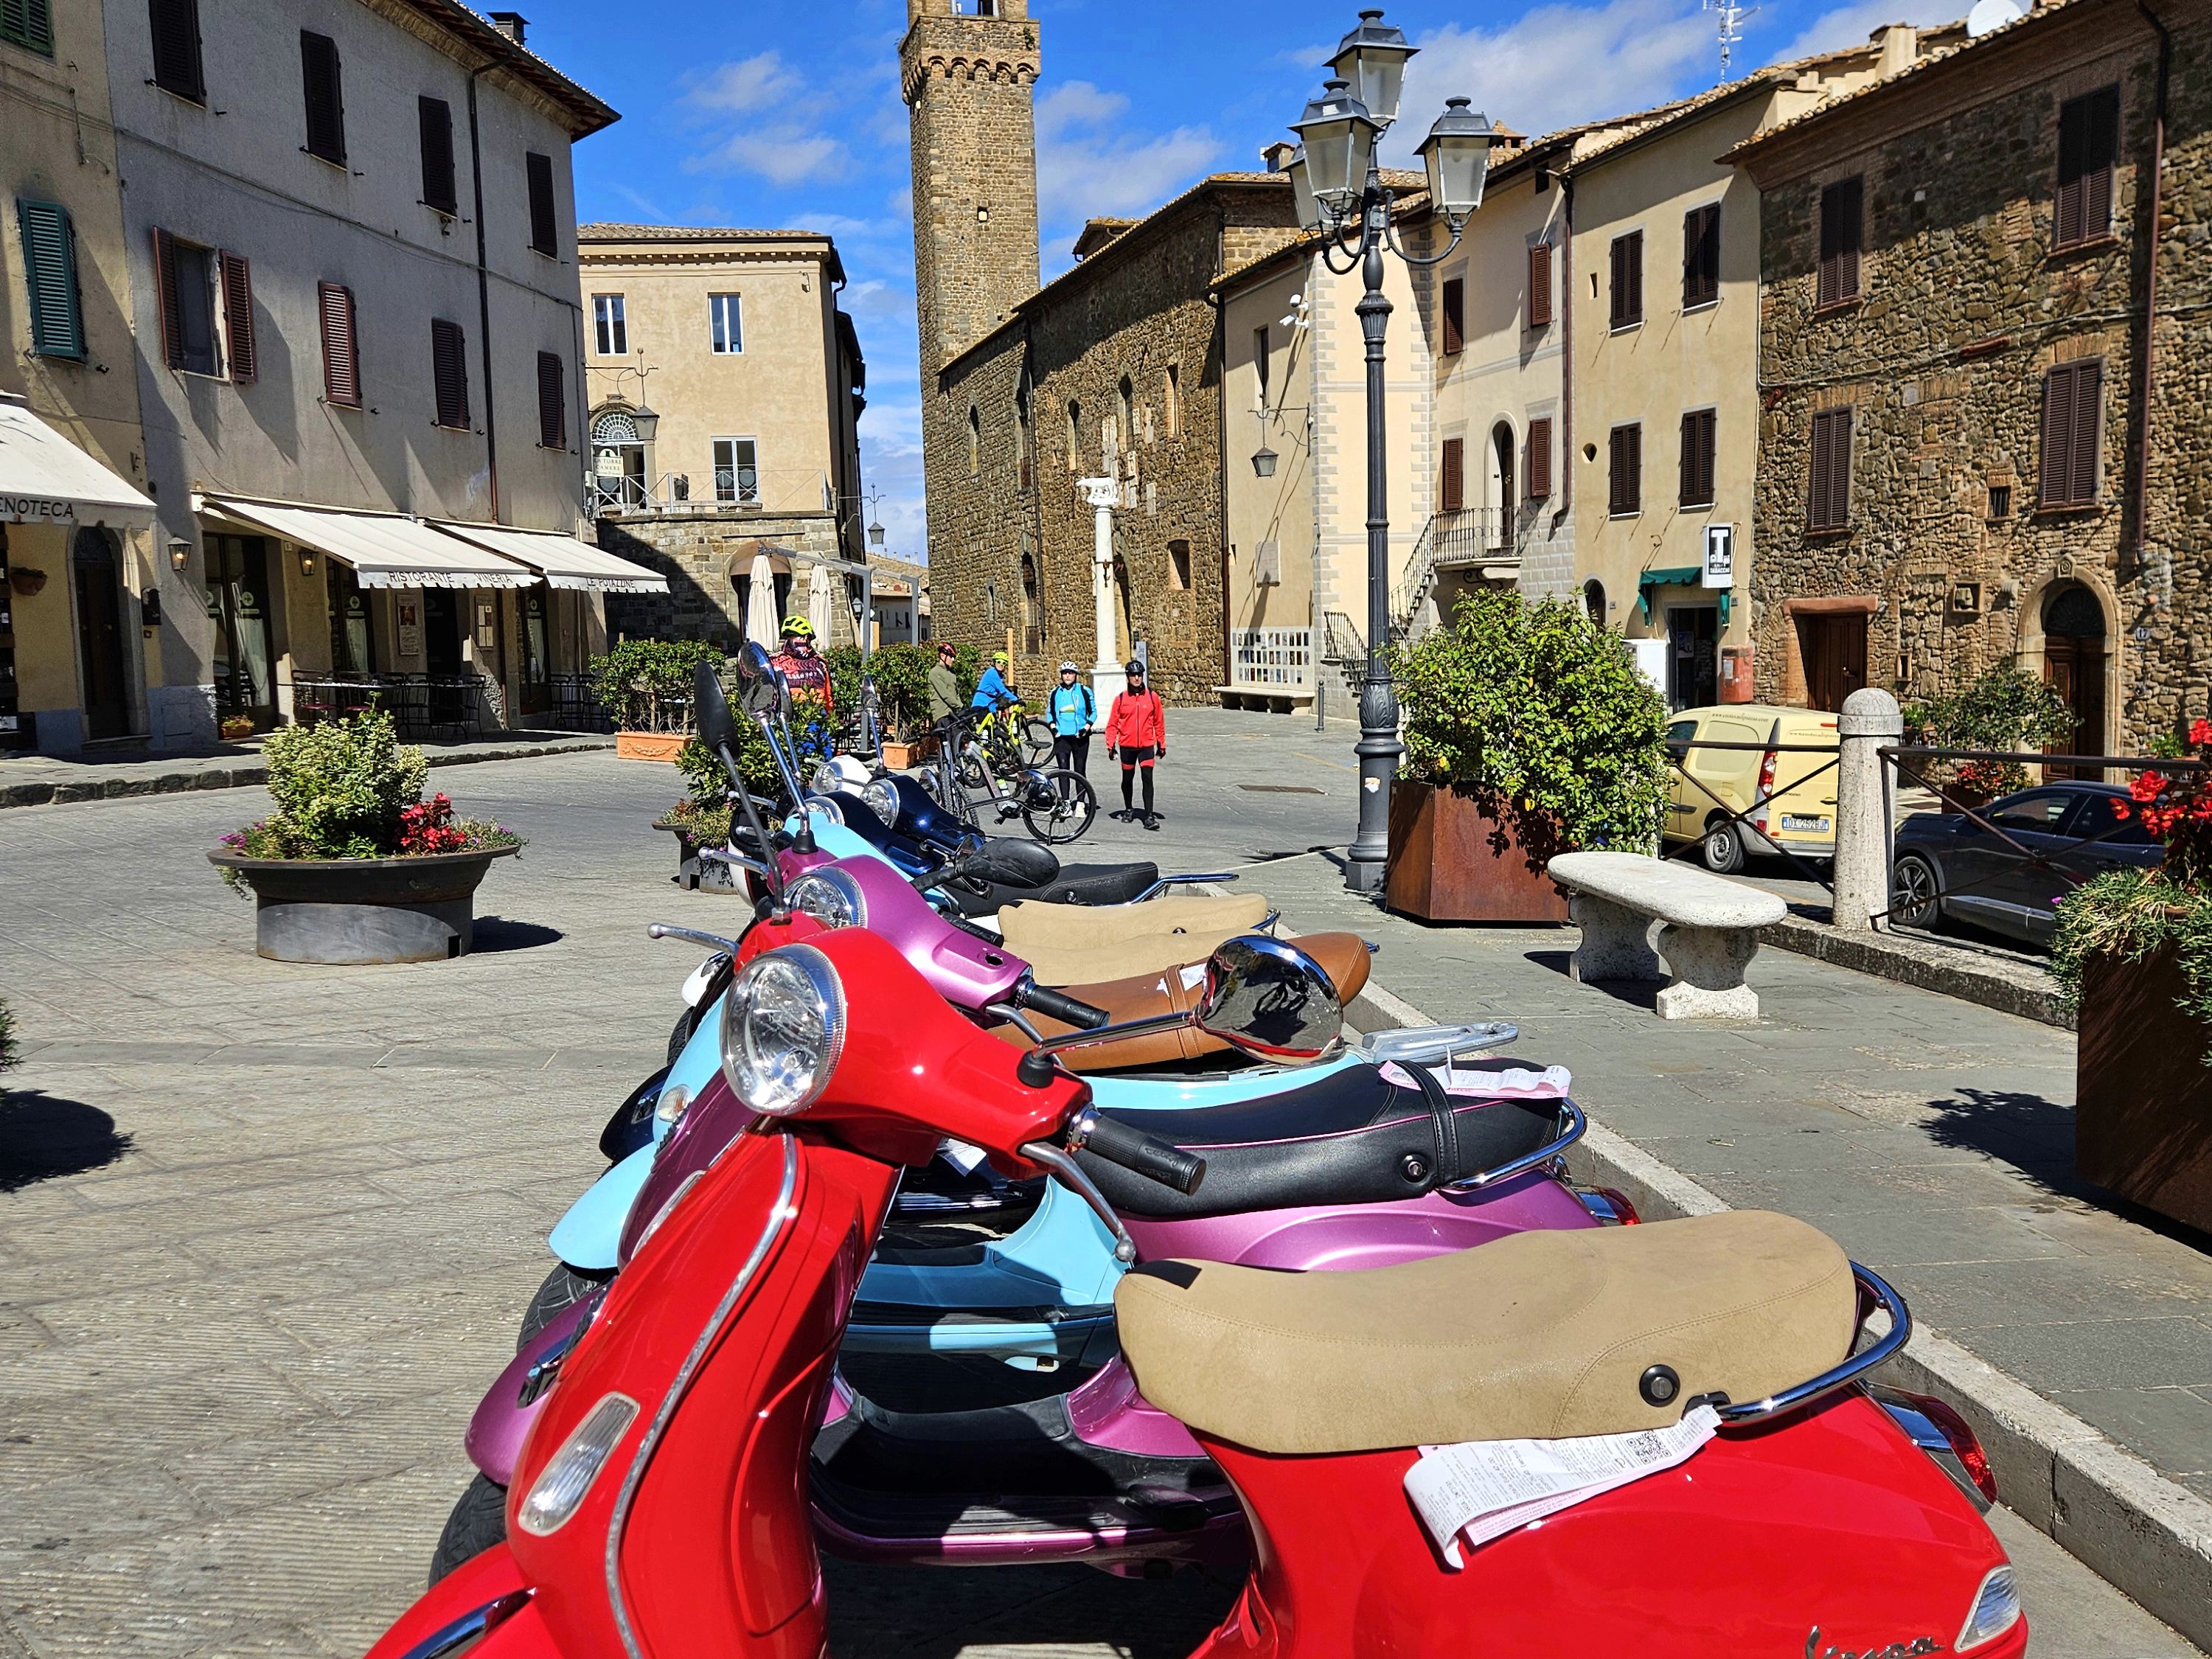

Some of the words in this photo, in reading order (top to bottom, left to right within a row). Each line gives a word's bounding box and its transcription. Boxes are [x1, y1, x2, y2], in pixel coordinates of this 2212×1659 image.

[0, 497, 74, 518] NOTECA
[389, 571, 454, 583] RISTORANTE
[475, 572, 513, 583] VINERIA
[586, 577, 595, 586] LE
[2139, 629, 2148, 638] 17
